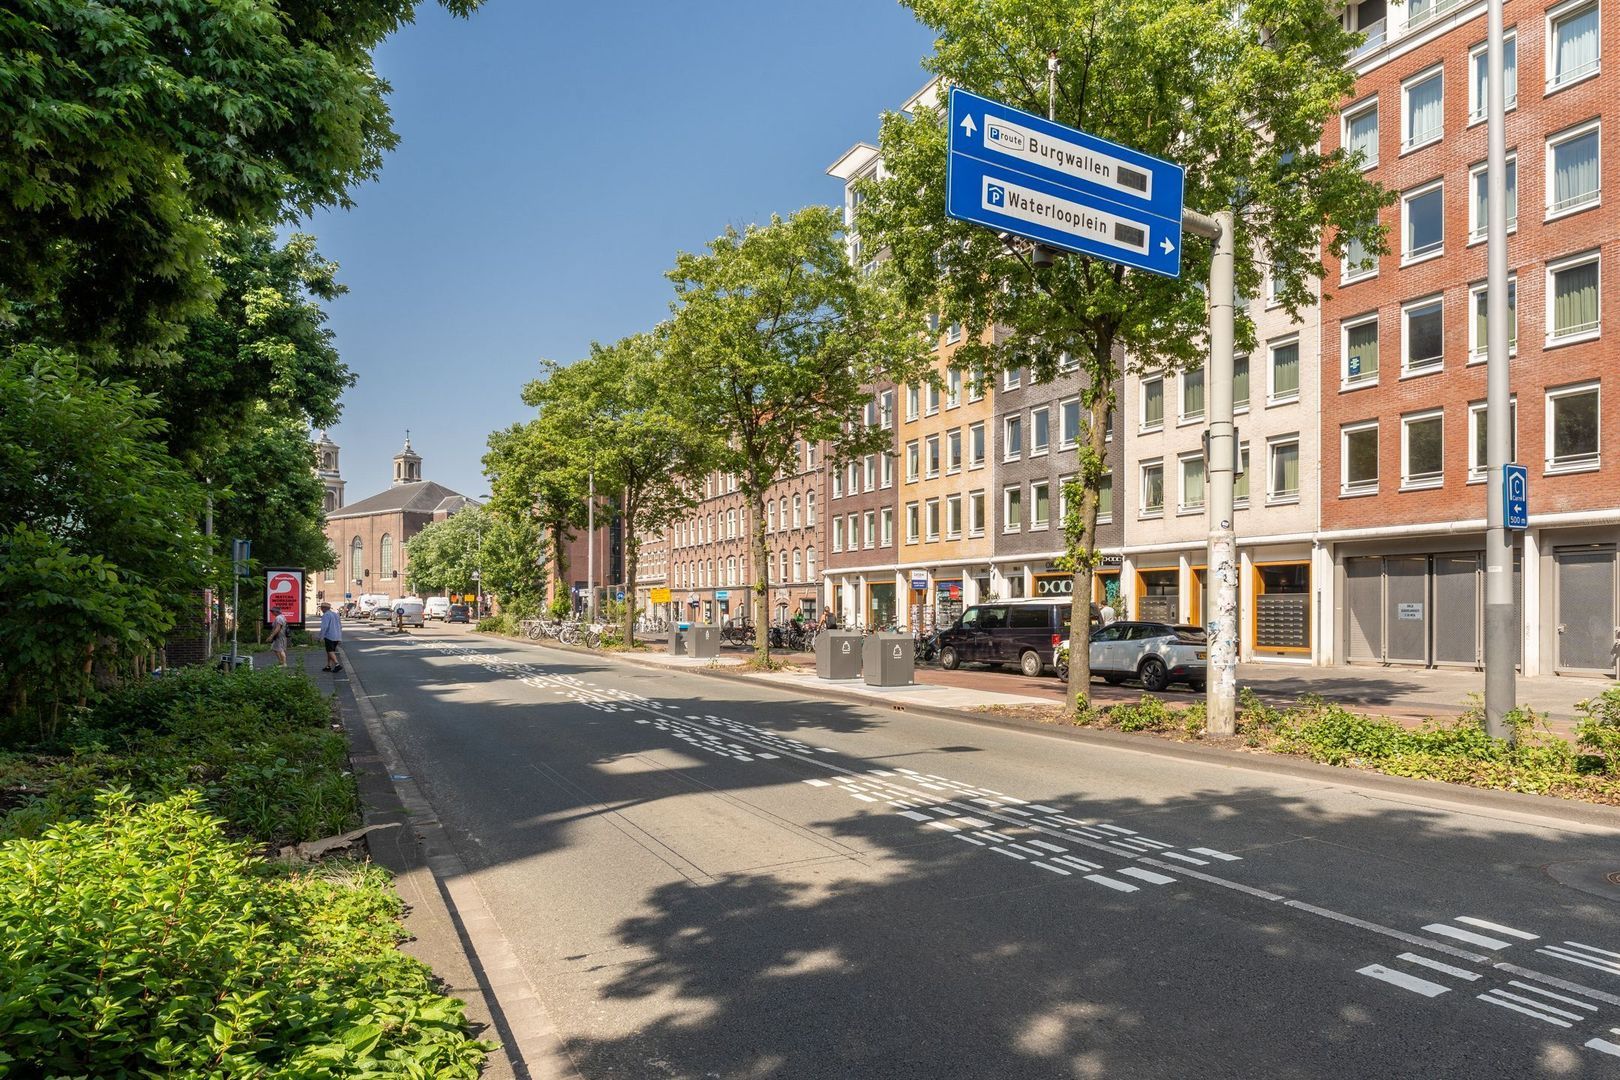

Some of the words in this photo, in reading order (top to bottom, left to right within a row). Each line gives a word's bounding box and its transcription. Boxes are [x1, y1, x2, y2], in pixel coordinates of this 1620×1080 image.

[1000, 133, 1022, 146] route
[1029, 138, 1110, 177] Burgwallen
[1008, 191, 1107, 233] Waterlooplein
[1510, 515, 1520, 524] 500
